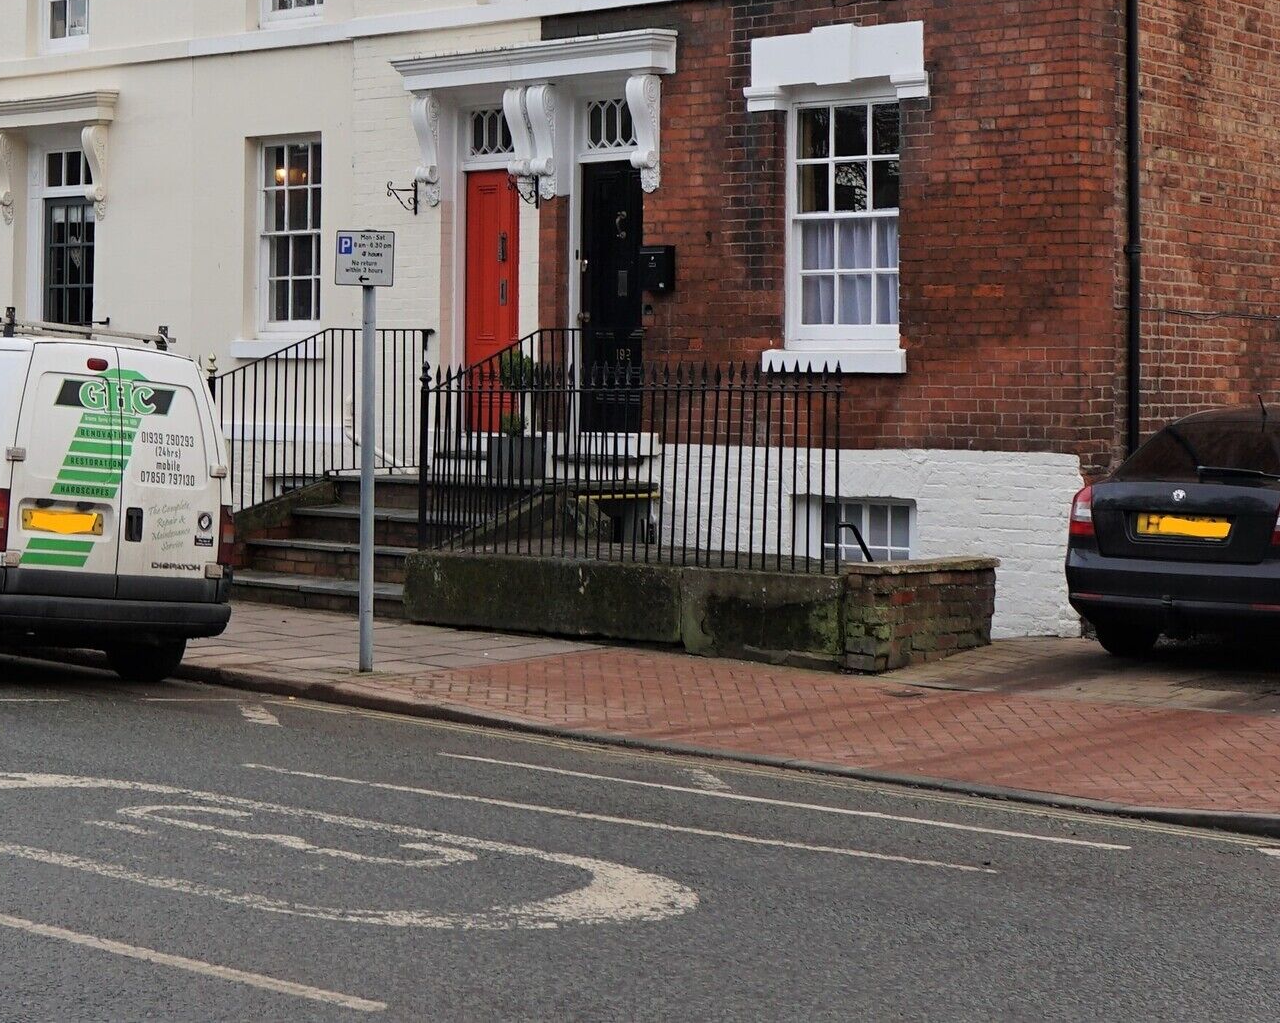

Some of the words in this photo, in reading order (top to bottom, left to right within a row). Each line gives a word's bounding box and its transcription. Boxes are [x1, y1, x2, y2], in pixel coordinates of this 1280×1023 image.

[341, 238, 351, 253] P
[79, 379, 157, 416] GHC
[81, 429, 133, 440] RENOVATION
[141, 431, 164, 445] 01939
[166, 433, 195, 448] 290293
[155, 446, 181, 460] (24hrs)
[70, 457, 122, 468] RESTORATION
[156, 461, 181, 472] mobile
[140, 471, 166, 485] 07850
[168, 473, 195, 487] 797130
[60, 485, 110, 497] HARDSCAPES
